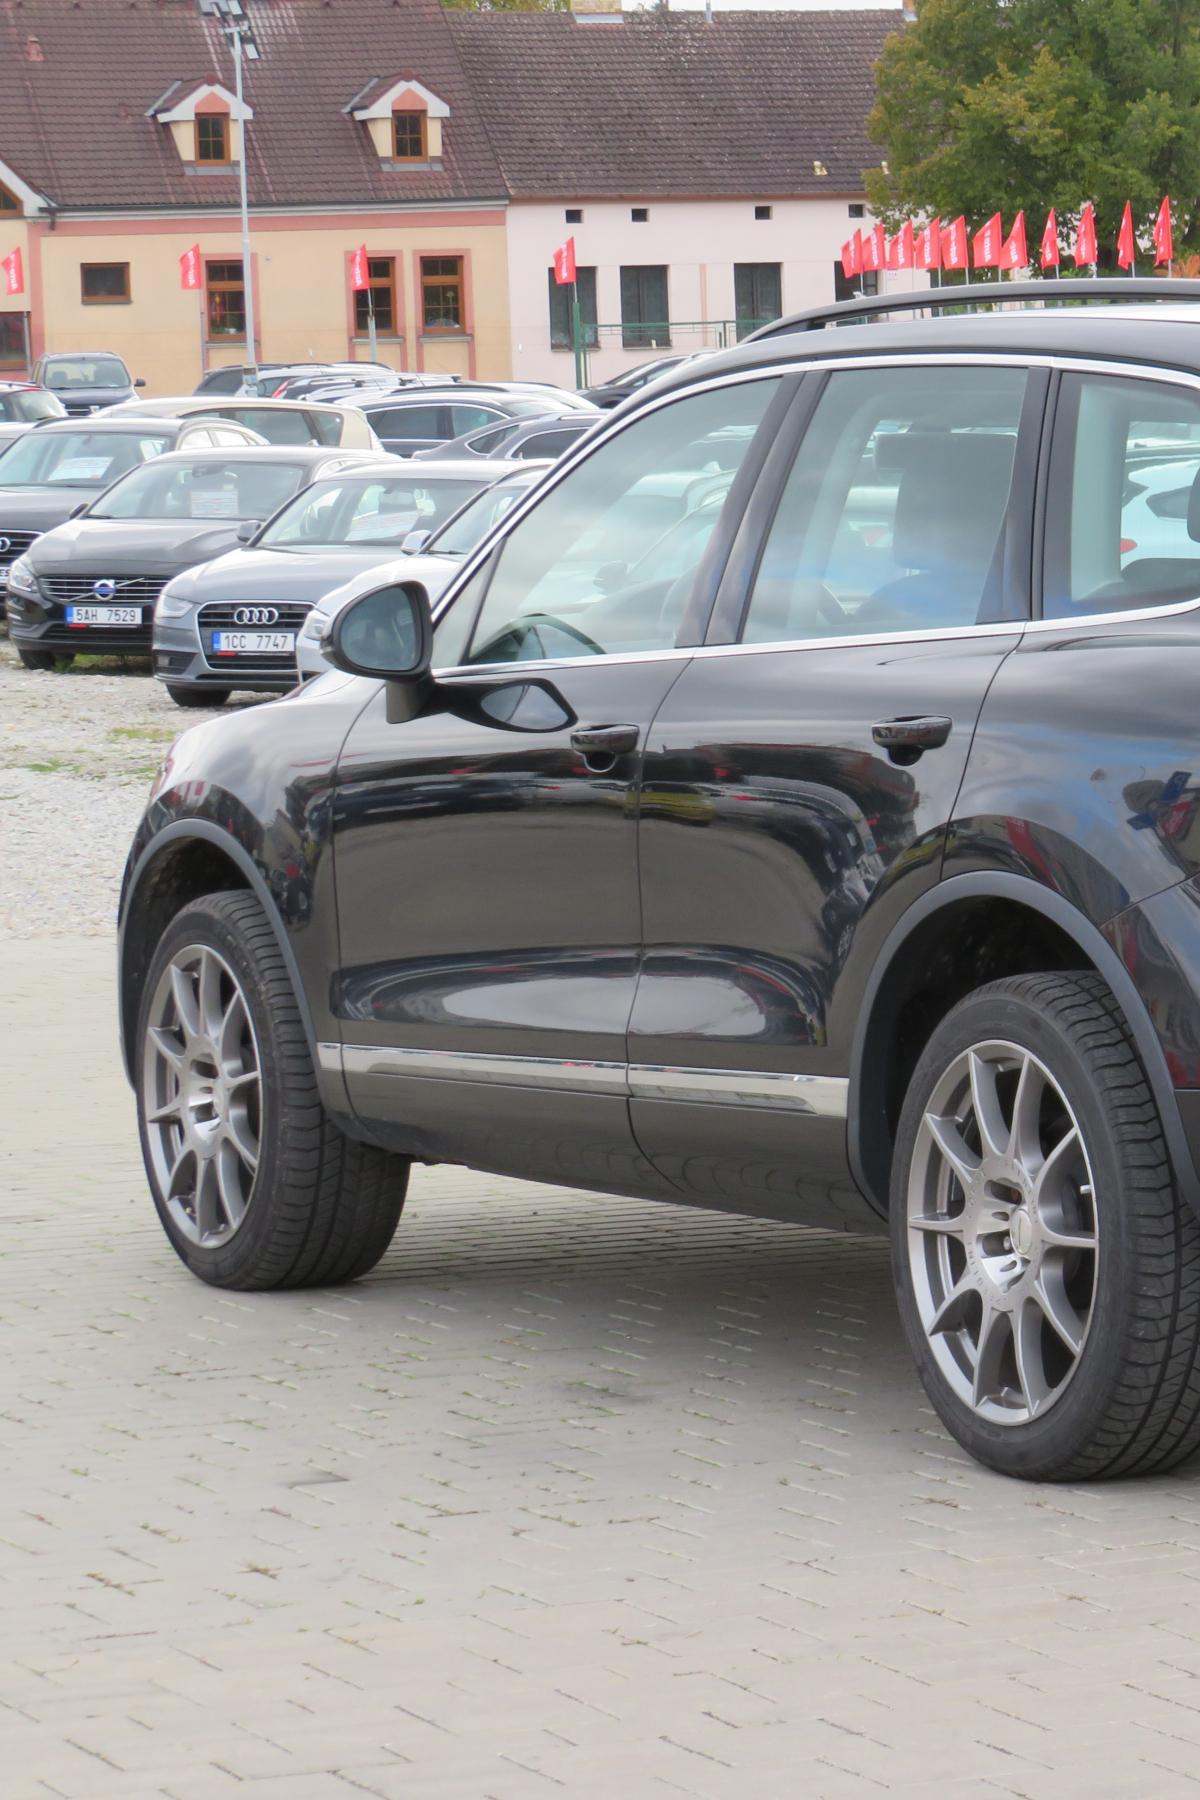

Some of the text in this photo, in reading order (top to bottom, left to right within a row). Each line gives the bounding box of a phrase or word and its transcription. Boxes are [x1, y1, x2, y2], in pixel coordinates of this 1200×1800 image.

[76, 608, 136, 622] 5AH 7529
[224, 634, 288, 649] 1CC 7747
